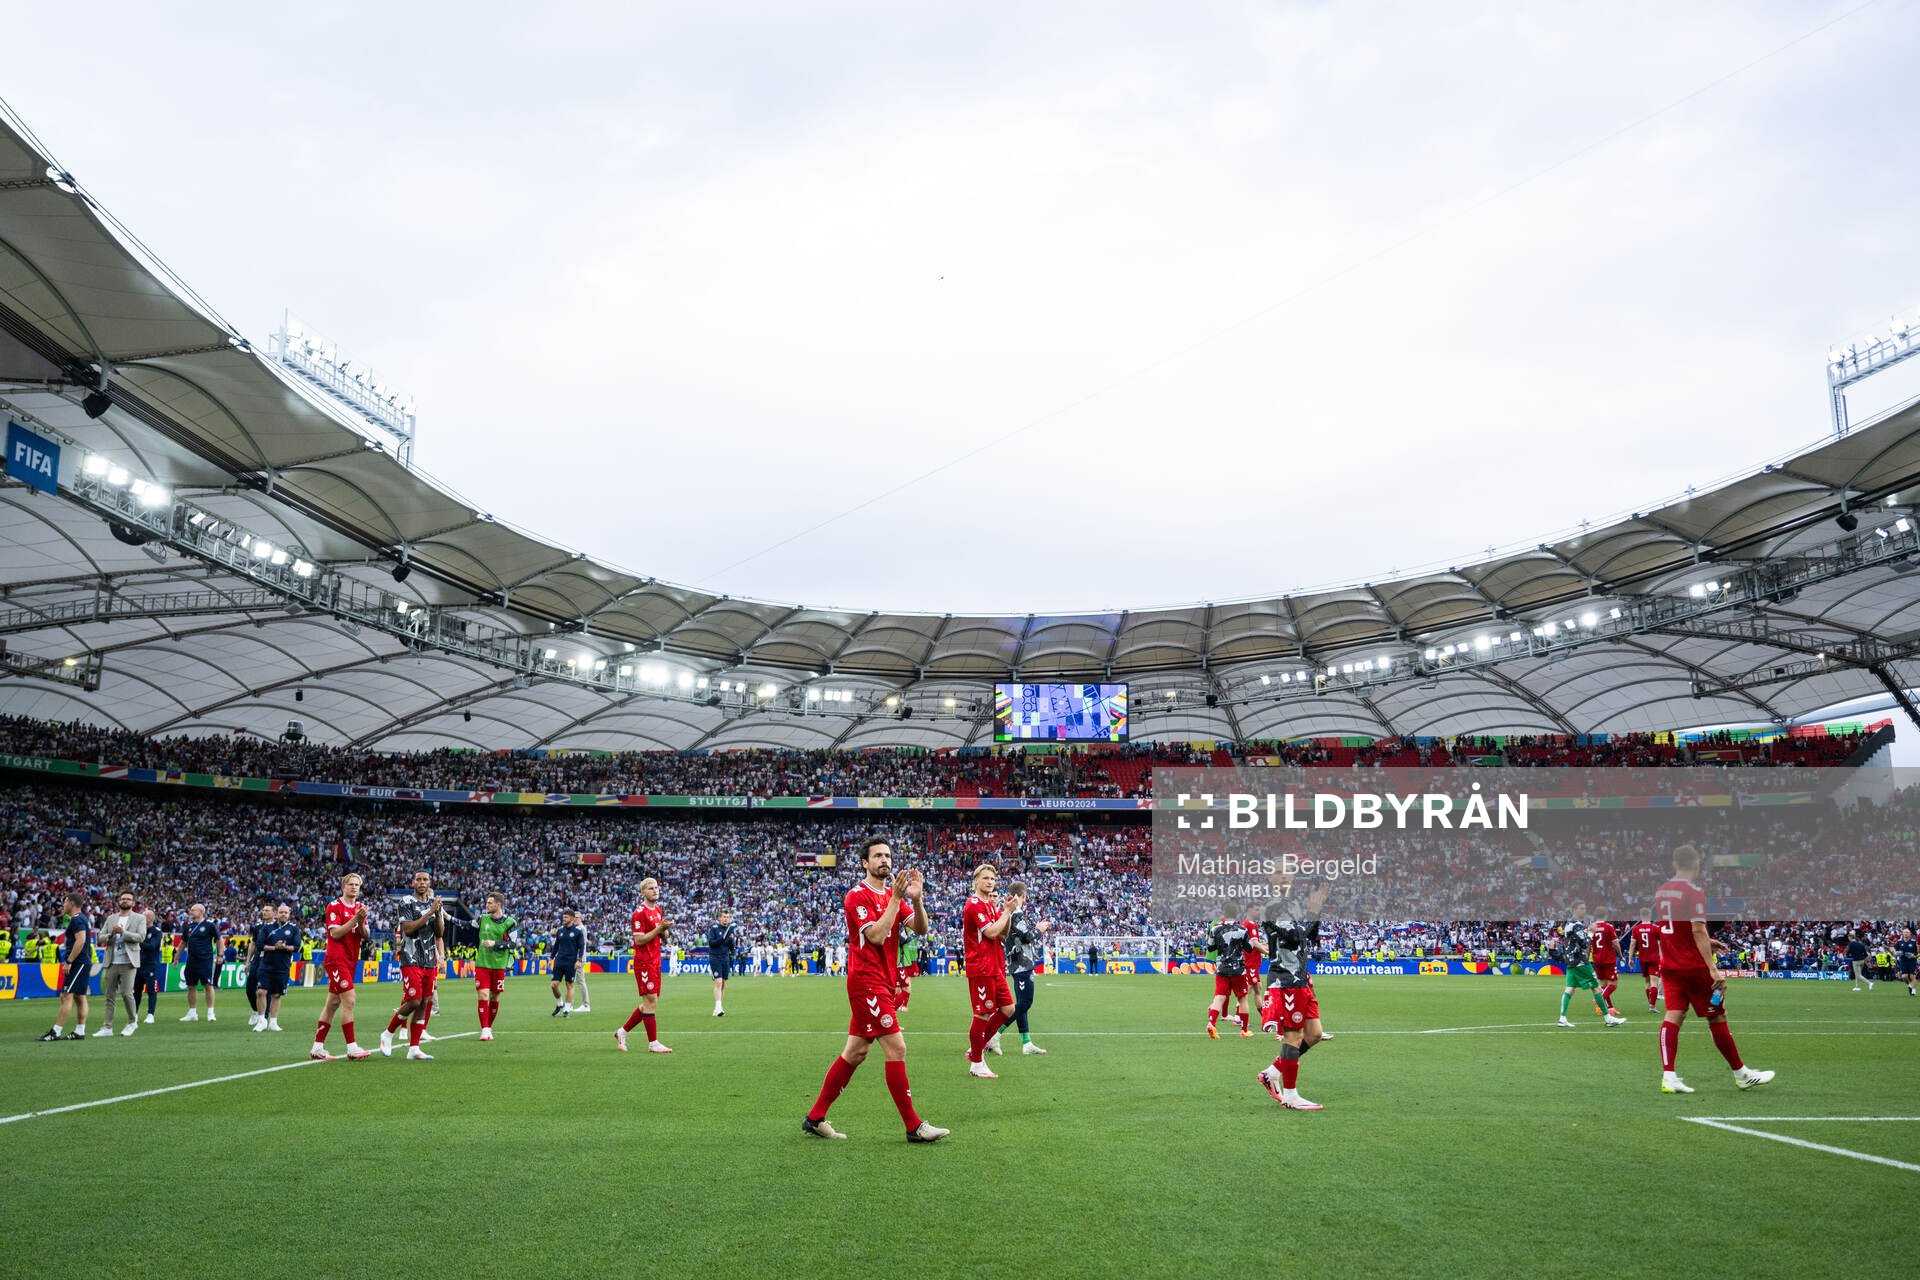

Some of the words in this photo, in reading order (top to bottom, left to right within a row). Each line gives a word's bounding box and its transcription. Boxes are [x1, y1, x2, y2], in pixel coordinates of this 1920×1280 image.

[15, 441, 52, 477] FIFA
[1046, 800, 1073, 808] EURO
[1074, 800, 1096, 808] 2024
[1660, 900, 1674, 934] 3
[1595, 932, 1604, 949] 2
[1641, 932, 1649, 948] 9
[1315, 963, 1404, 975] #onyourteam
